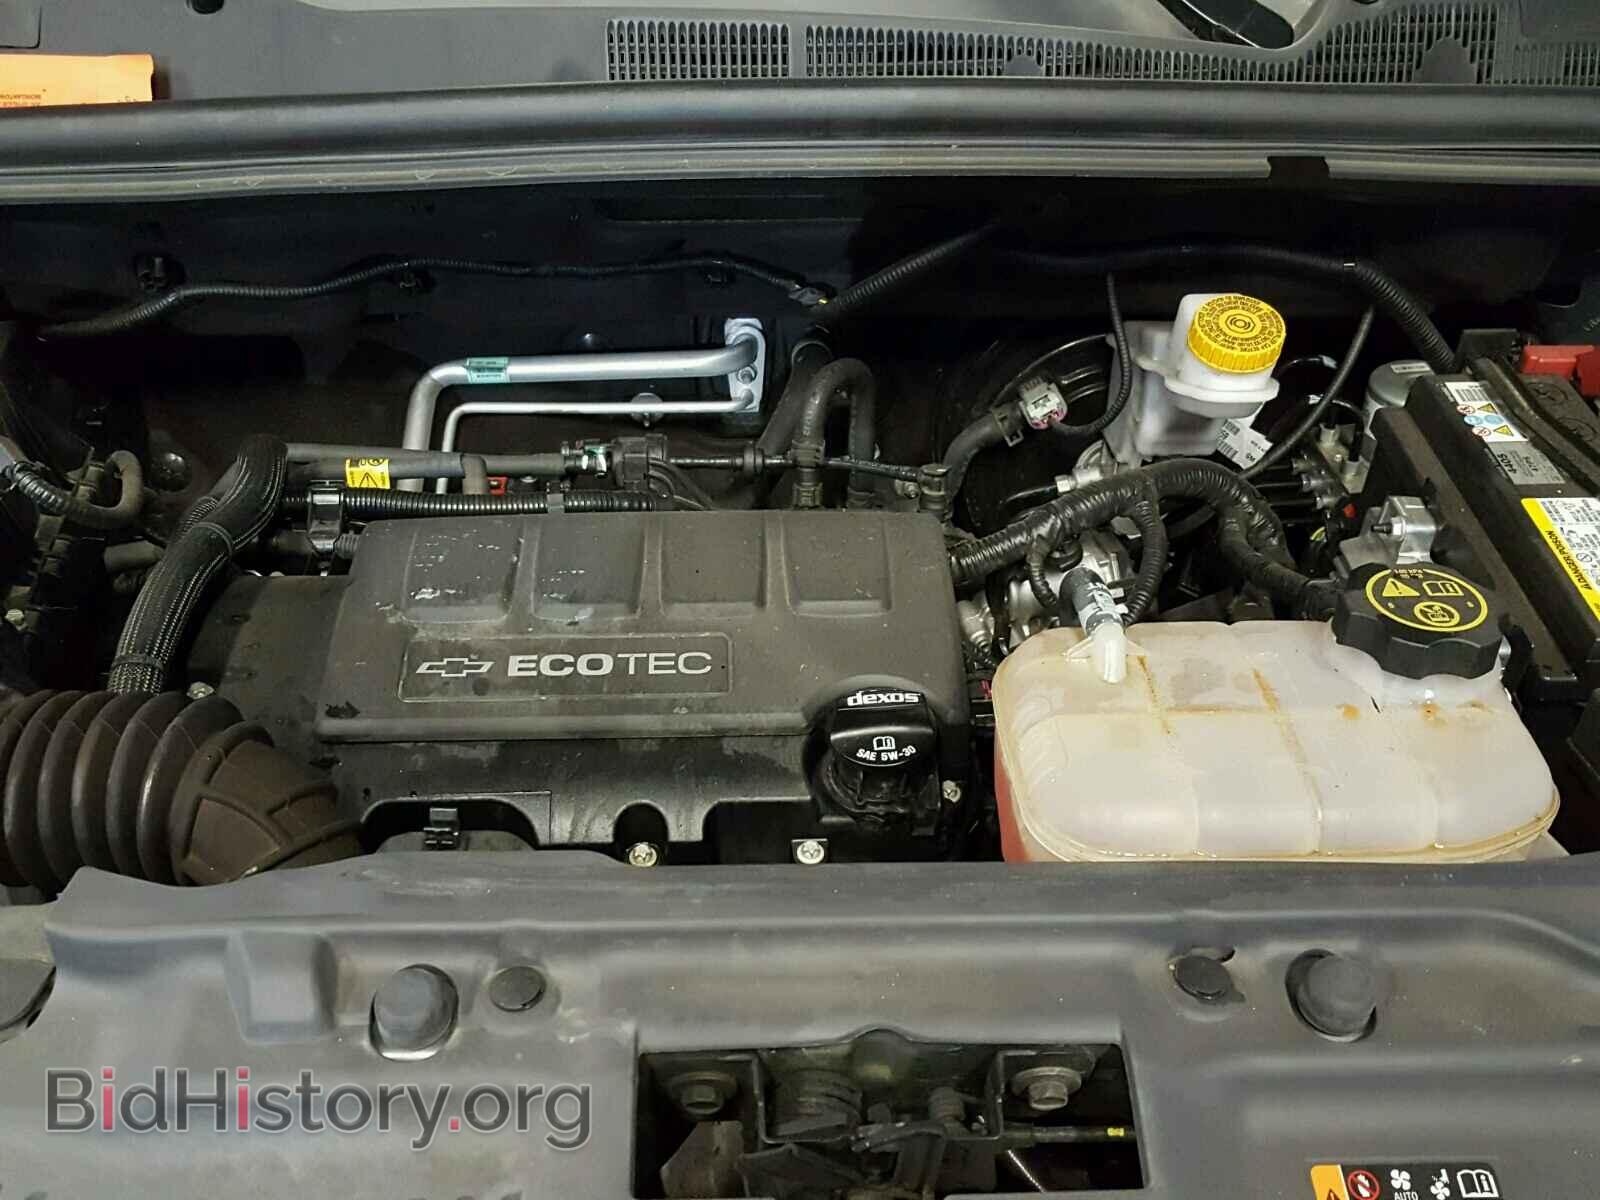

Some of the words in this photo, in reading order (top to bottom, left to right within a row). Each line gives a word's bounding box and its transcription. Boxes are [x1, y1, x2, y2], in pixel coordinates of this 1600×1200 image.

[507, 651, 712, 677] ECOTEC
[847, 690, 921, 707] dexos
[856, 748, 877, 761] SAE
[880, 744, 917, 761] 5W-30
[1394, 1191, 1419, 1200] AUTO
